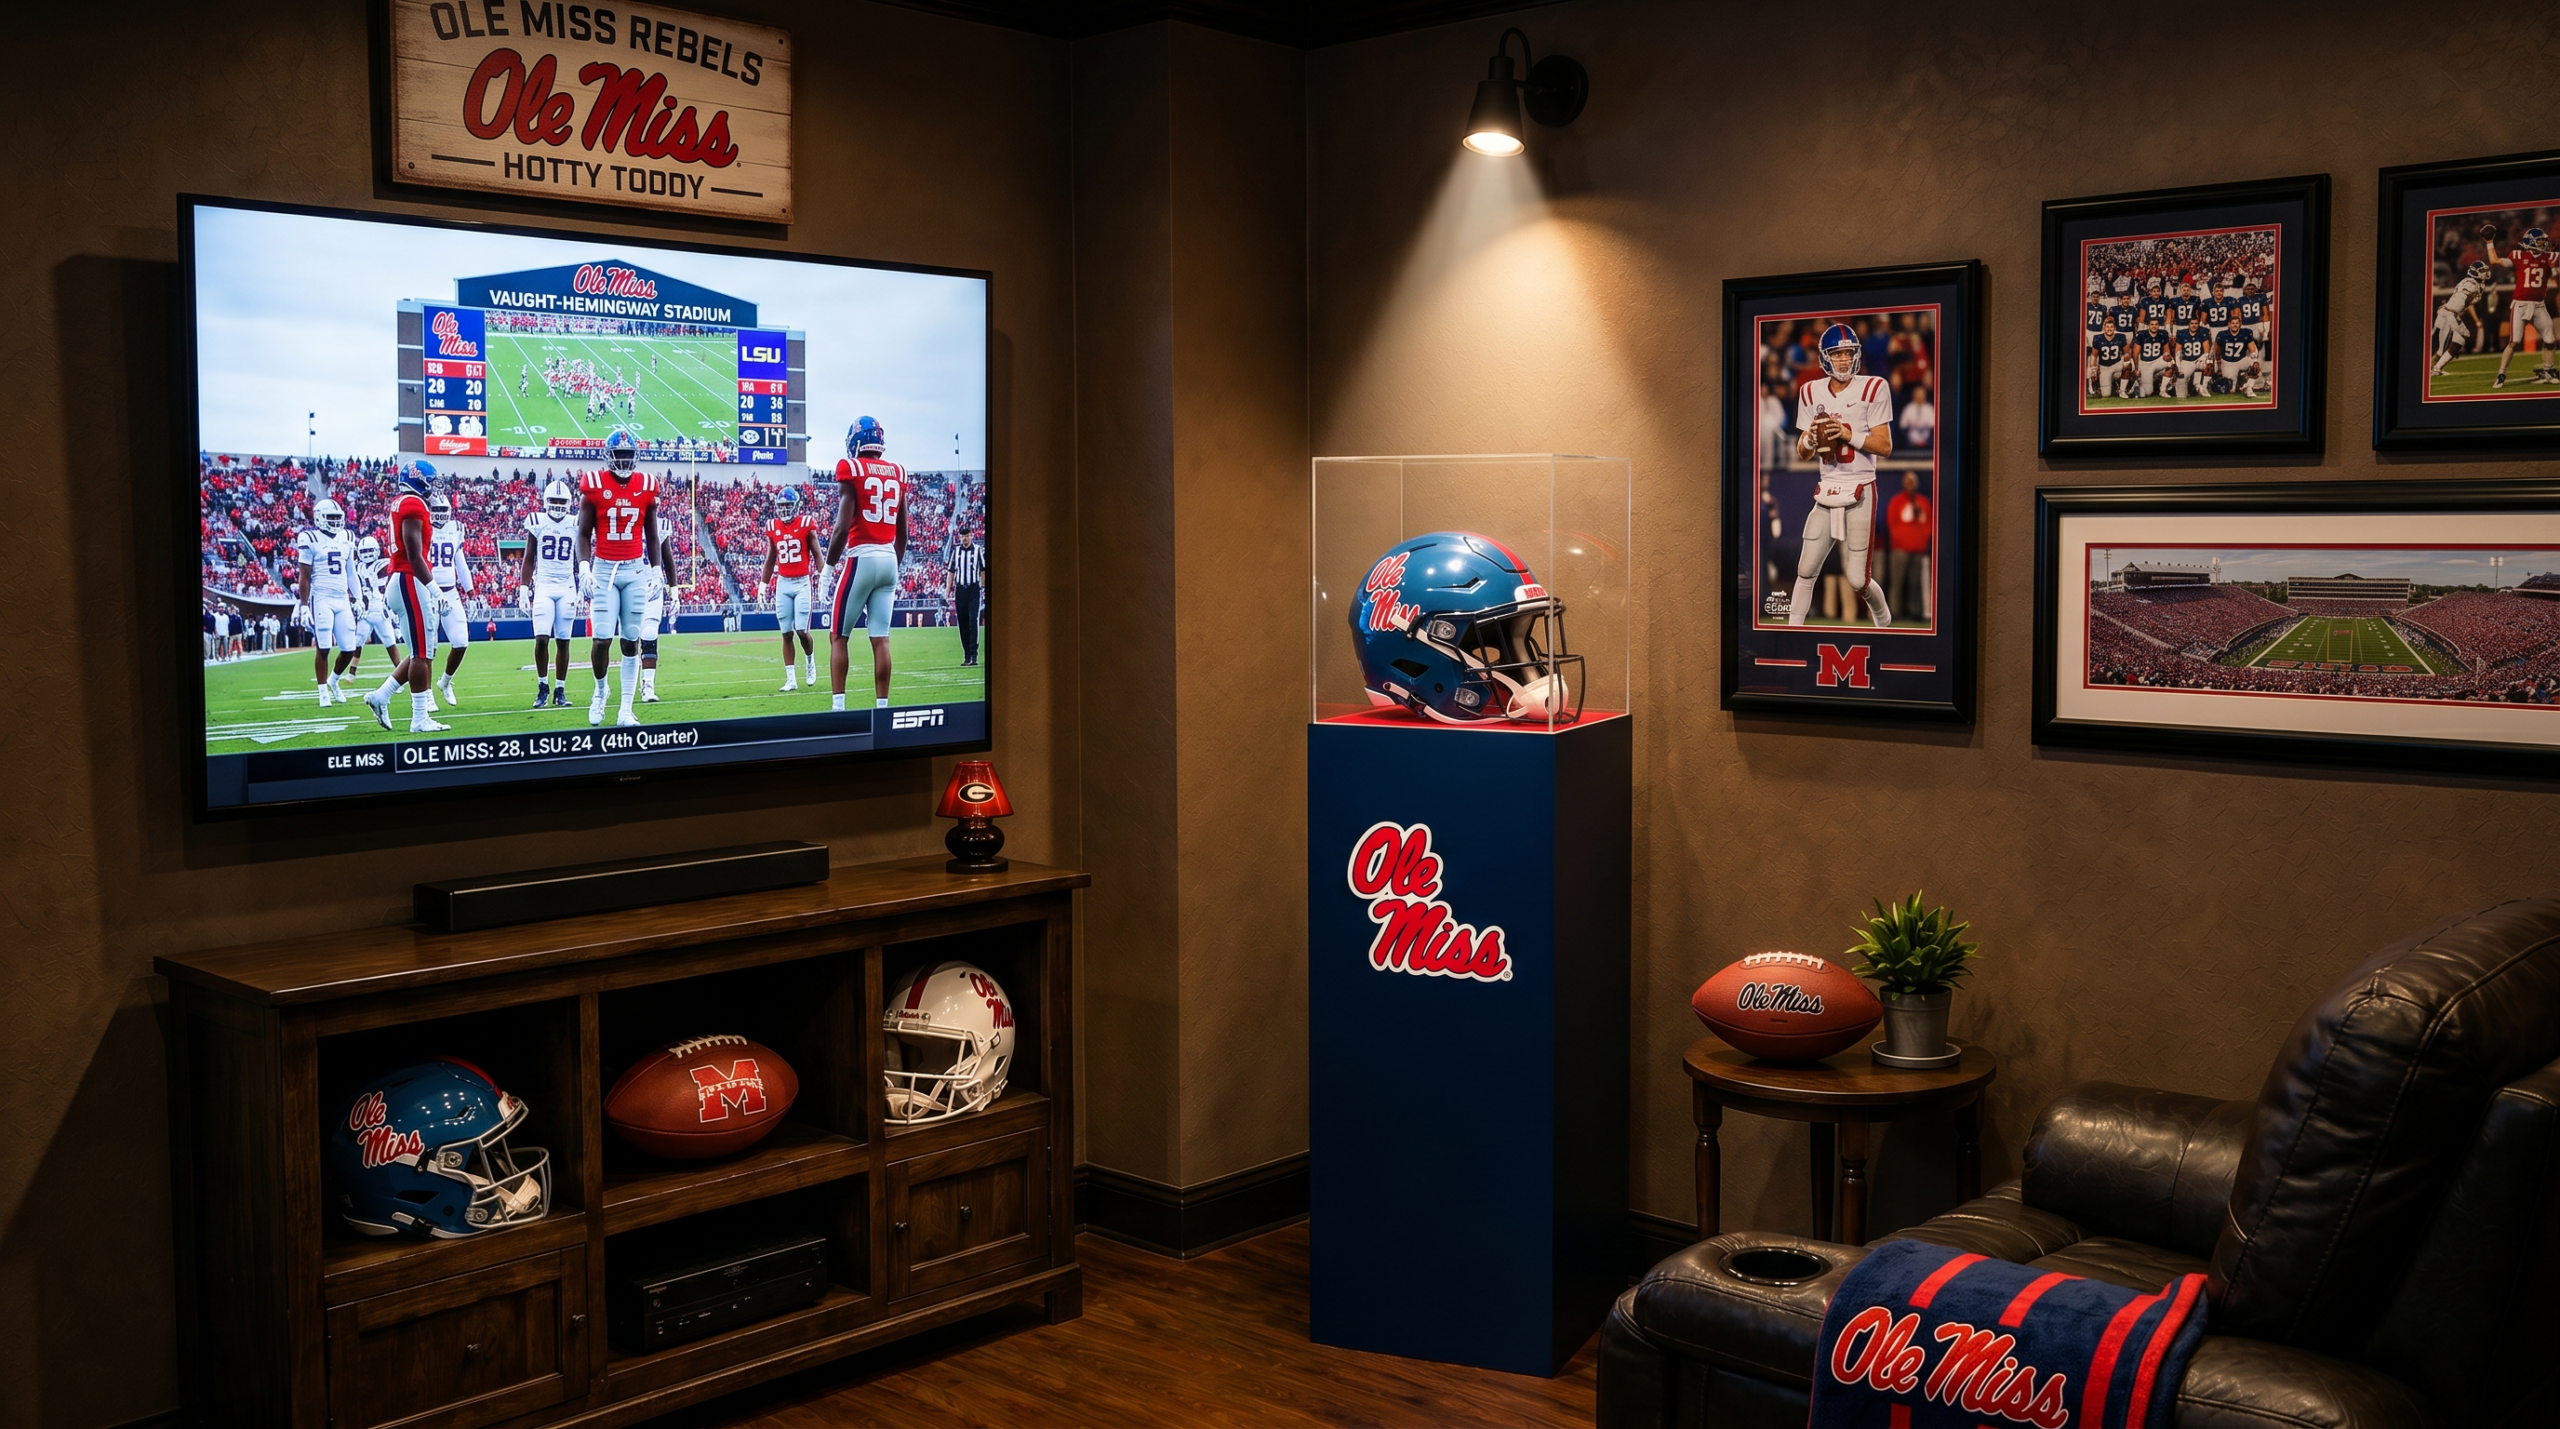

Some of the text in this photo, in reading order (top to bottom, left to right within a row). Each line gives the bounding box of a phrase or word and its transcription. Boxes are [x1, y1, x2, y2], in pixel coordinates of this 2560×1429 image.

[430, 0, 763, 87] OLE MISS REBELS
[463, 47, 739, 168] Ole Miss
[504, 152, 705, 200] HOTTY TODDY
[573, 264, 657, 300] Ole Miss
[2523, 267, 2544, 288] 13
[432, 311, 459, 335] Ole
[489, 289, 731, 323] VAUGHT-HEMINGWAY STADIUM
[741, 345, 781, 364] LSU
[2101, 345, 2120, 361] 33
[862, 476, 901, 525] 32
[606, 506, 640, 541] 17
[327, 551, 342, 575] 5
[776, 538, 802, 564] 82
[1365, 551, 1411, 592] Ole
[1816, 643, 1871, 689] M
[892, 708, 945, 729] ESPN
[403, 728, 699, 765] OLE MISS: 28, LSU: 24 (4th Quarter)
[1347, 820, 1444, 899] Ole
[1368, 899, 1511, 983] Miss
[1737, 981, 1825, 1016] Ole Miss
[689, 1058, 767, 1124] M
[349, 1090, 388, 1132] Ole
[356, 1124, 426, 1170] Miss
[1831, 1305, 2069, 1429] Ole Miss
